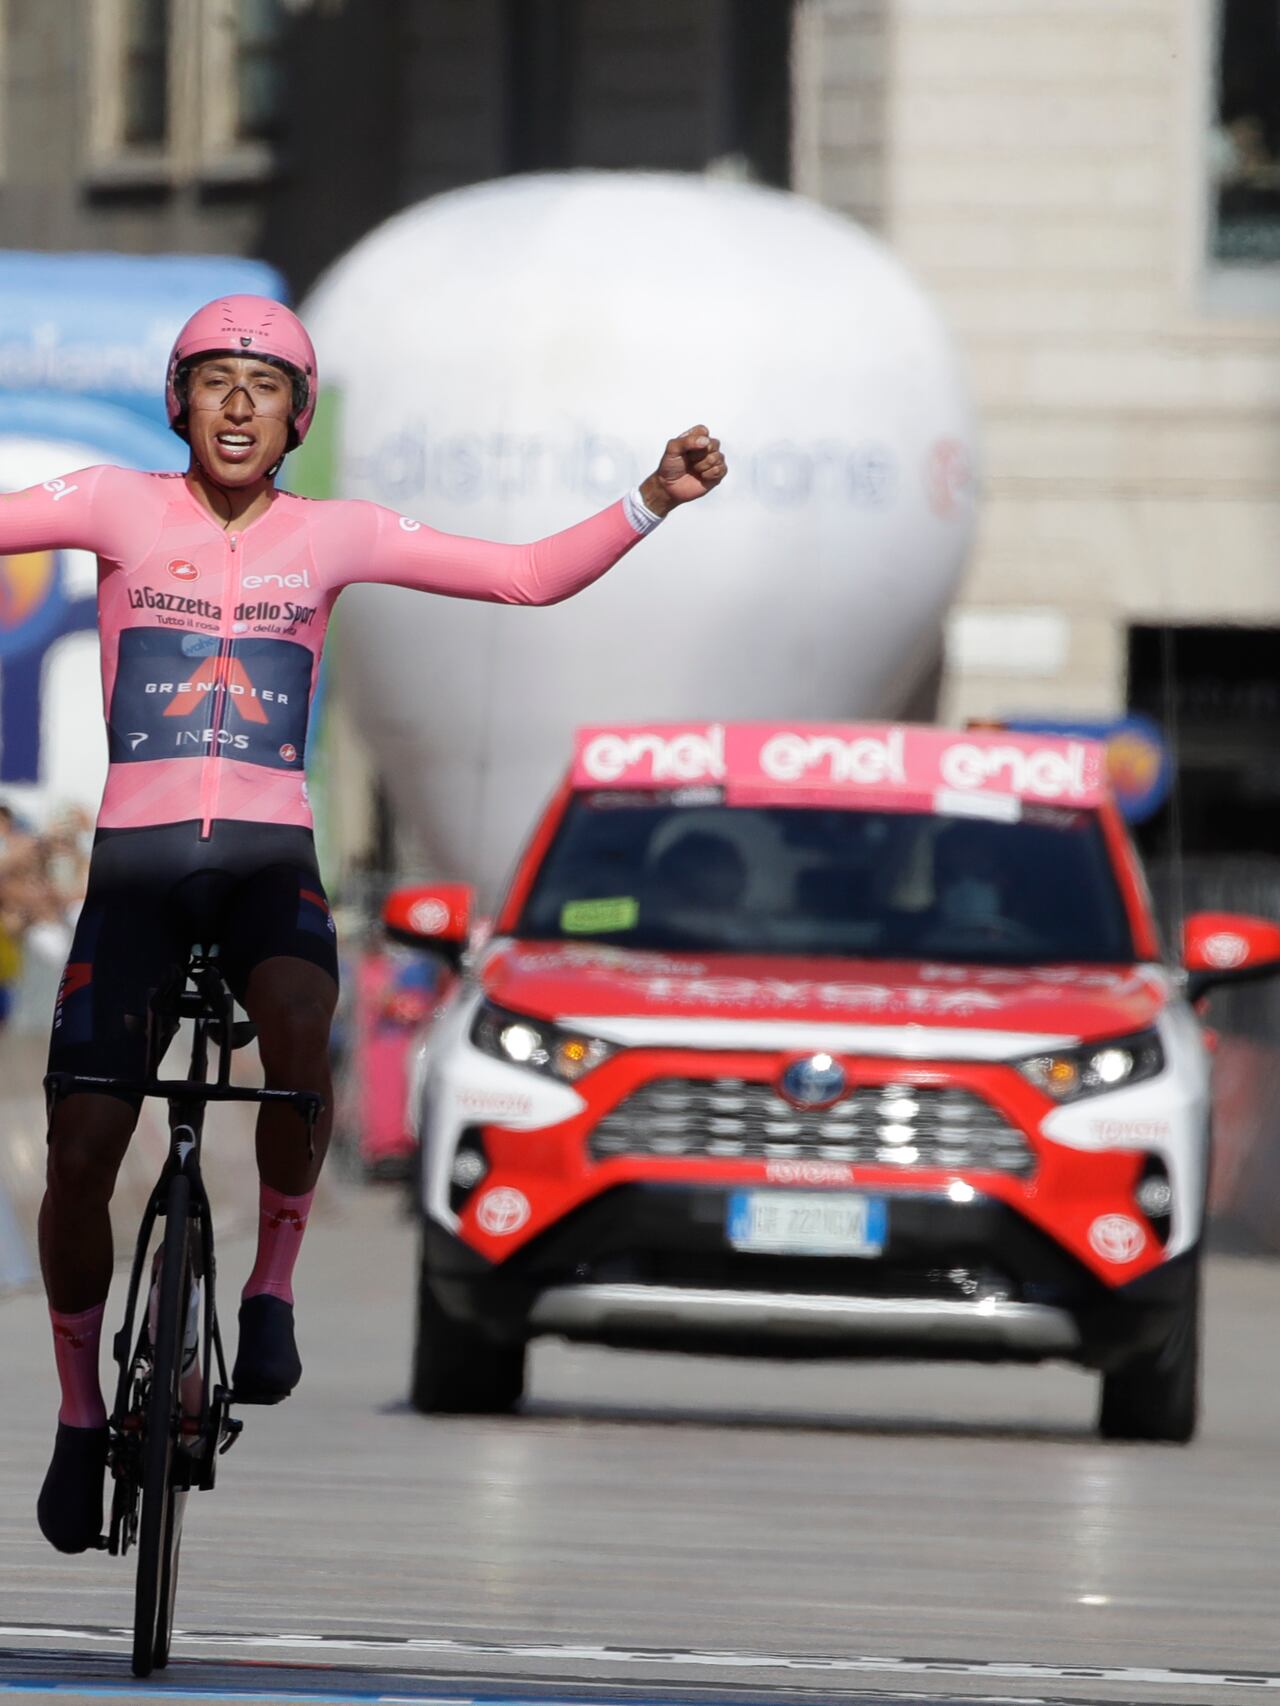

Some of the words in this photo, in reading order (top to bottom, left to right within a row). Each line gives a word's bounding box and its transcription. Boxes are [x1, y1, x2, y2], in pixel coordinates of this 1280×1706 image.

[242, 569, 310, 589] enel
[233, 602, 281, 621] dello
[156, 614, 185, 627] Tutto
[195, 620, 220, 632] rosa
[253, 622, 281, 633] della
[144, 682, 289, 705] GRENADIER
[175, 728, 251, 750] INEOS
[582, 723, 724, 781] enel
[760, 729, 906, 783] enel
[940, 743, 1086, 798] enel
